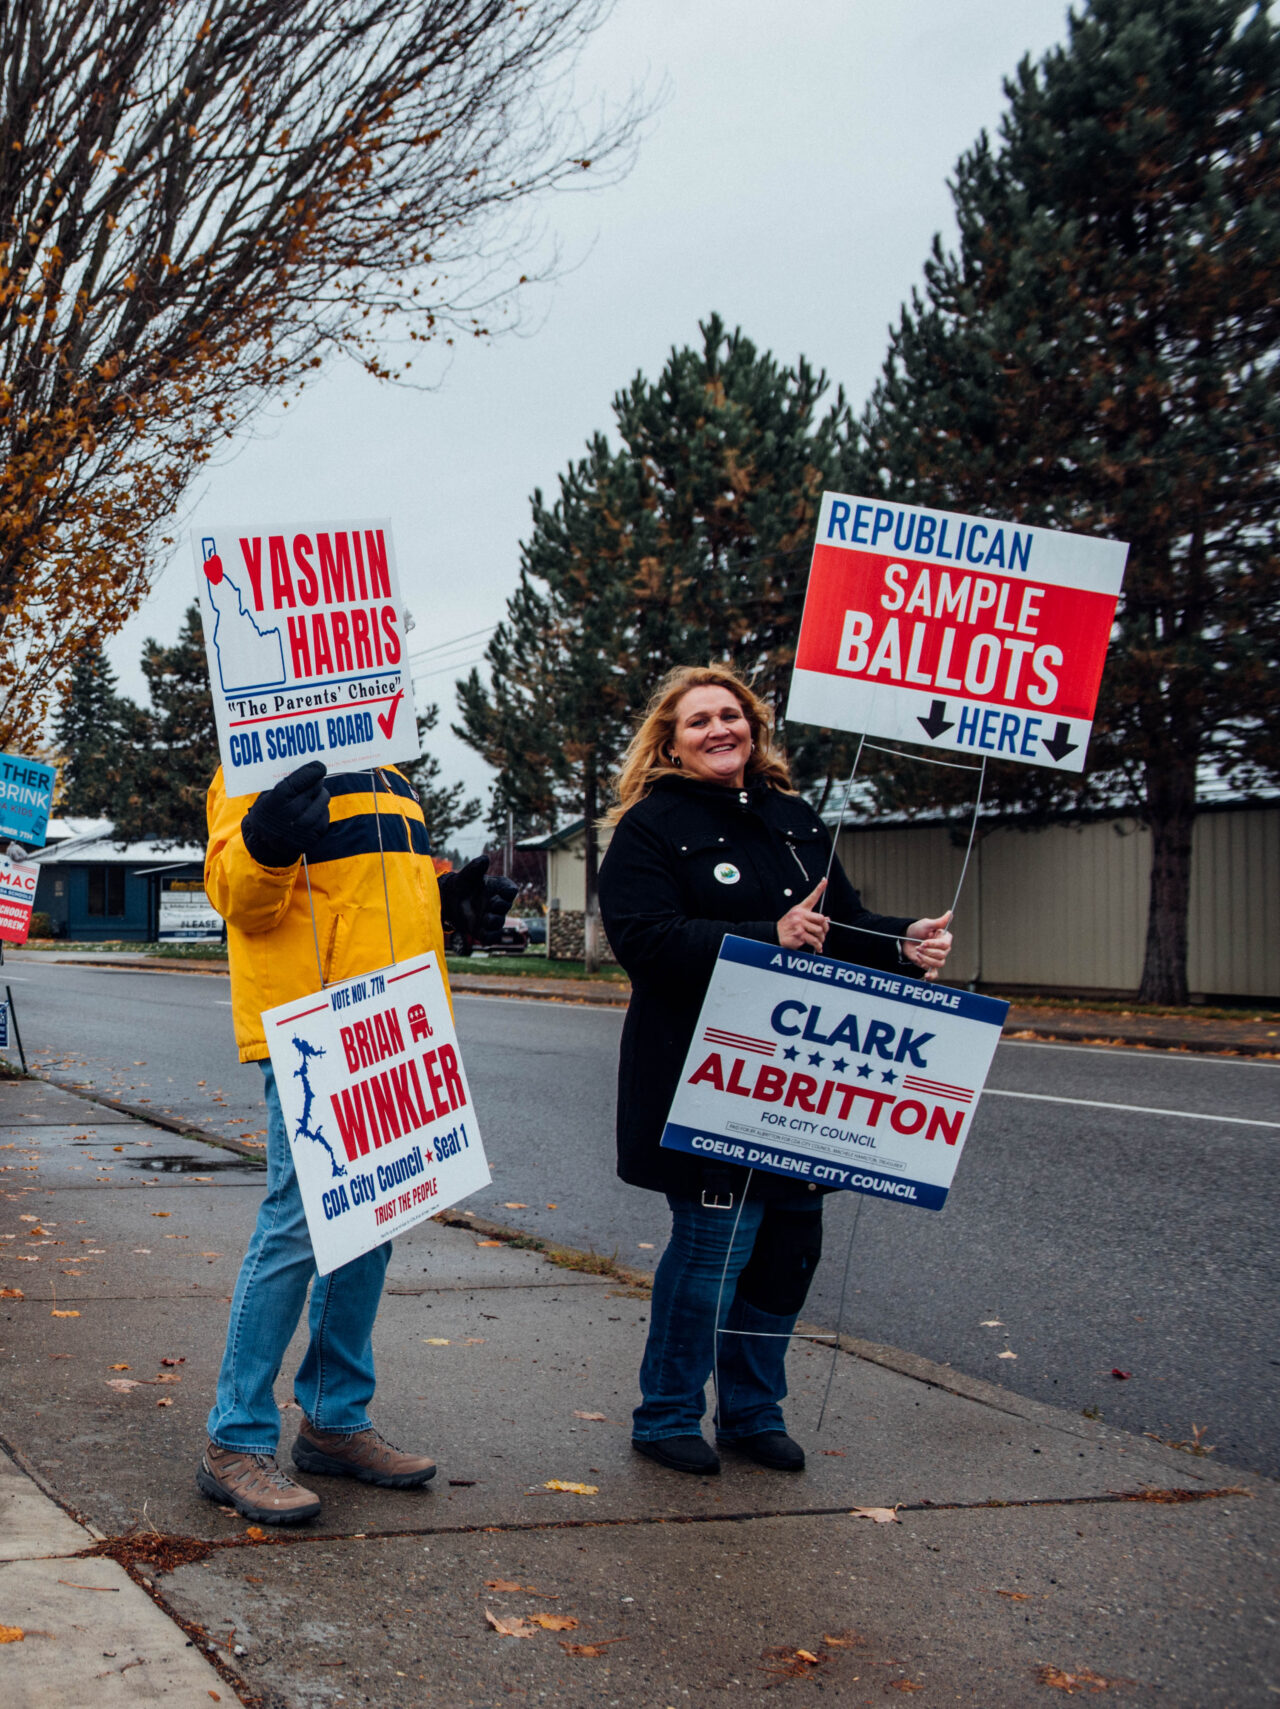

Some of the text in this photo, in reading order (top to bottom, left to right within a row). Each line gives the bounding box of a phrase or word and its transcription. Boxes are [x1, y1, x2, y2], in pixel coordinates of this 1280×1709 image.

[827, 500, 1034, 573] REPUBLICAN
[238, 529, 392, 611] YASMIN
[880, 563, 1045, 636] SAMPLE
[287, 605, 402, 679] HARRIS
[836, 609, 1064, 707] BALLOTS
[229, 711, 374, 767] CDA SCHOOL BOARD
[956, 705, 1043, 757] HERE
[10, 803, 33, 818] KIDS
[20, 829, 34, 841] 7TH
[0, 867, 36, 891] MAC
[330, 975, 386, 1012] VOTE NOV. 7TH
[770, 954, 961, 1010] A VOICE FOR THE PEOPLE
[339, 1007, 406, 1075] BRIAN
[770, 1000, 936, 1069] CLARK
[330, 1043, 467, 1163] WINKLER
[688, 1053, 966, 1147] ALBRITTON
[760, 1112, 877, 1149] FOR CITY COUNCIL
[321, 1187, 349, 1221] CDA
[350, 1175, 377, 1204] City
[376, 1146, 425, 1192] Council
[432, 1129, 460, 1162] Seat
[460, 1123, 470, 1149] 1
[691, 1136, 918, 1200] COEUR D'ALENE CITY COUNCIL
[374, 1198, 397, 1226] TRUST
[398, 1191, 412, 1213] THE
[413, 1177, 438, 1206] PEOPLE
